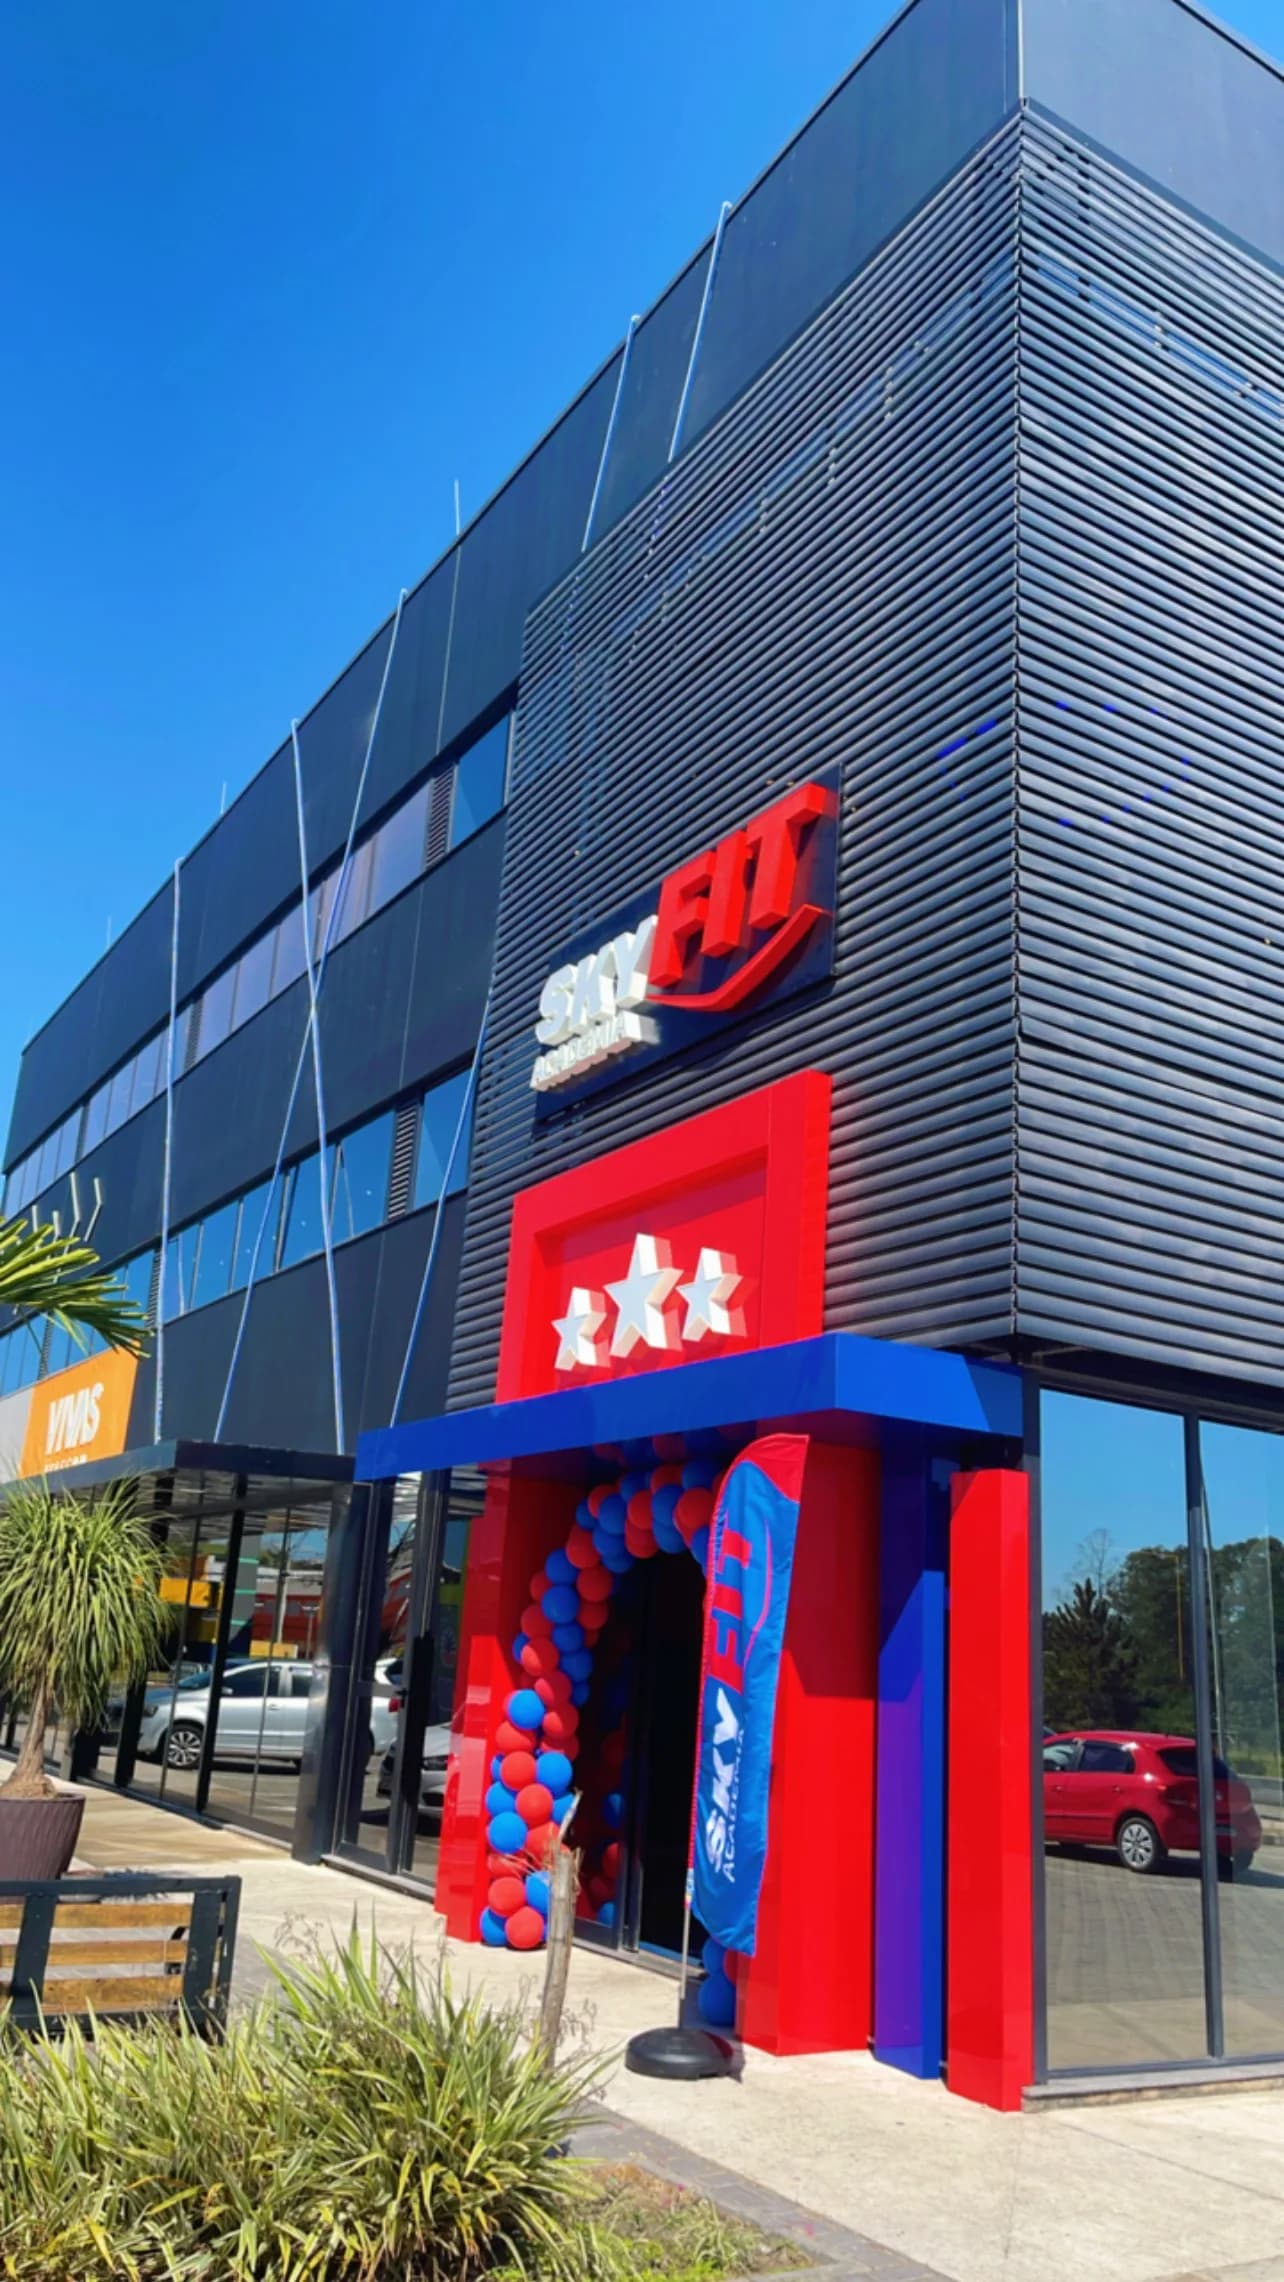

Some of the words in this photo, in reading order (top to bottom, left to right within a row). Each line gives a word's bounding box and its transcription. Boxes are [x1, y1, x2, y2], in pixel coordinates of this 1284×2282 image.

[535, 914, 659, 1045] SKY
[648, 782, 826, 988] FIT
[706, 1687, 739, 1873] SKY
[722, 1728, 745, 1883] ACADEMIA
